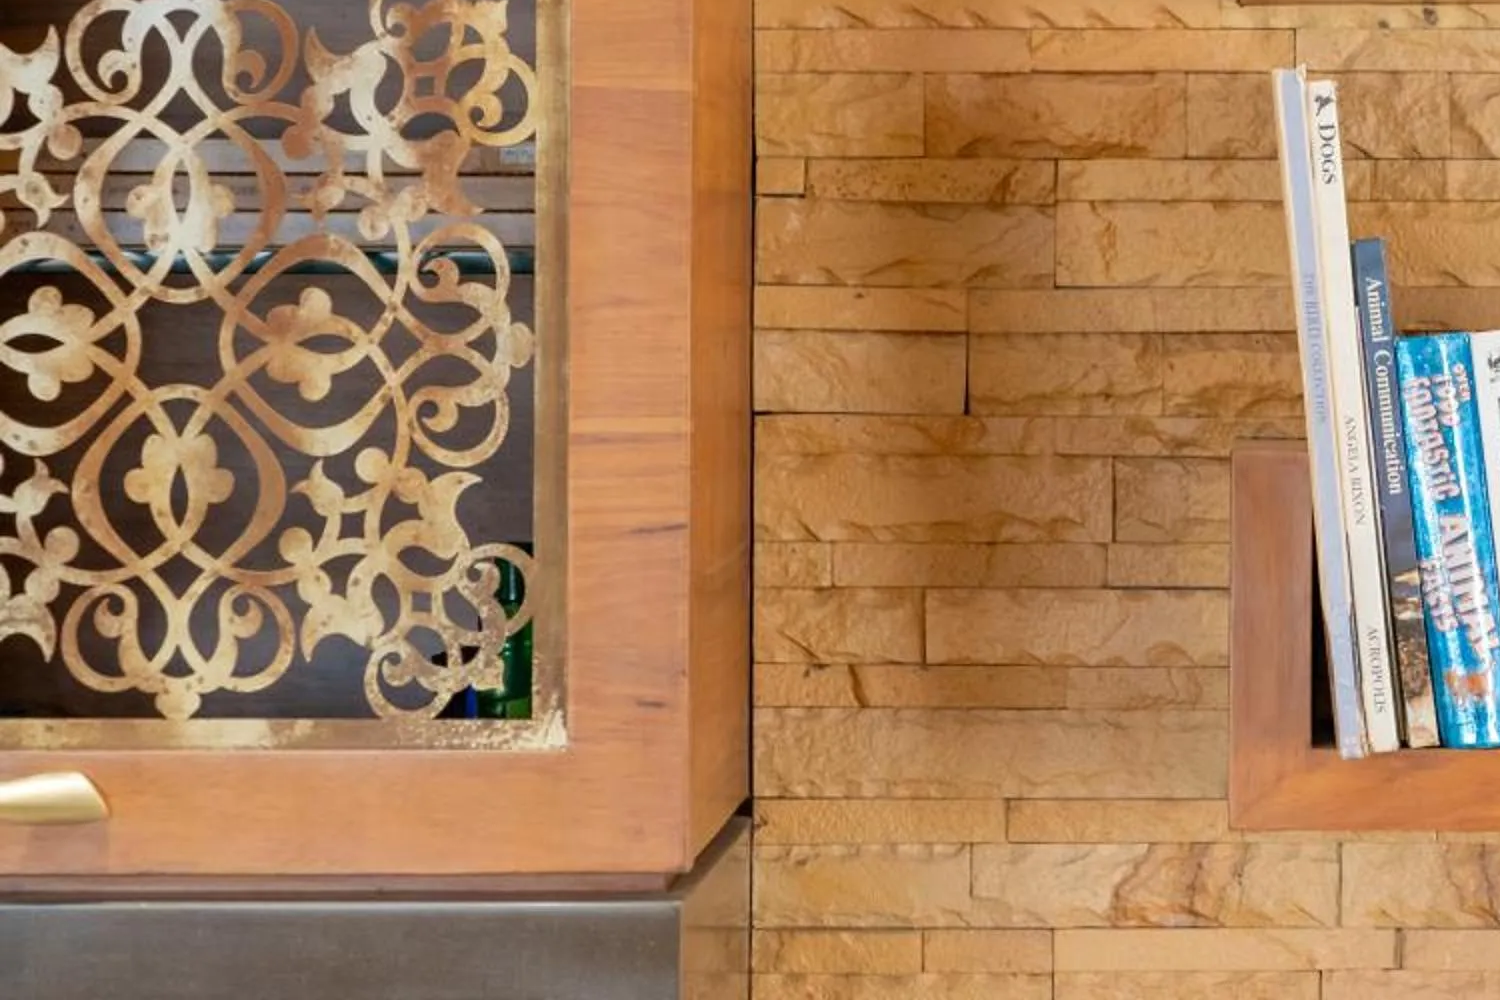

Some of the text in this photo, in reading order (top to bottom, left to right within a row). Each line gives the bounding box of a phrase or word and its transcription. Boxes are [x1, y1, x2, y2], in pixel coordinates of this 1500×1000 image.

[1318, 122, 1336, 185] DOGS
[1365, 275, 1406, 495] Animal Communication
[1342, 415, 1366, 525] ANGELA RIXON
[1364, 625, 1387, 714] ACROPOLIS
